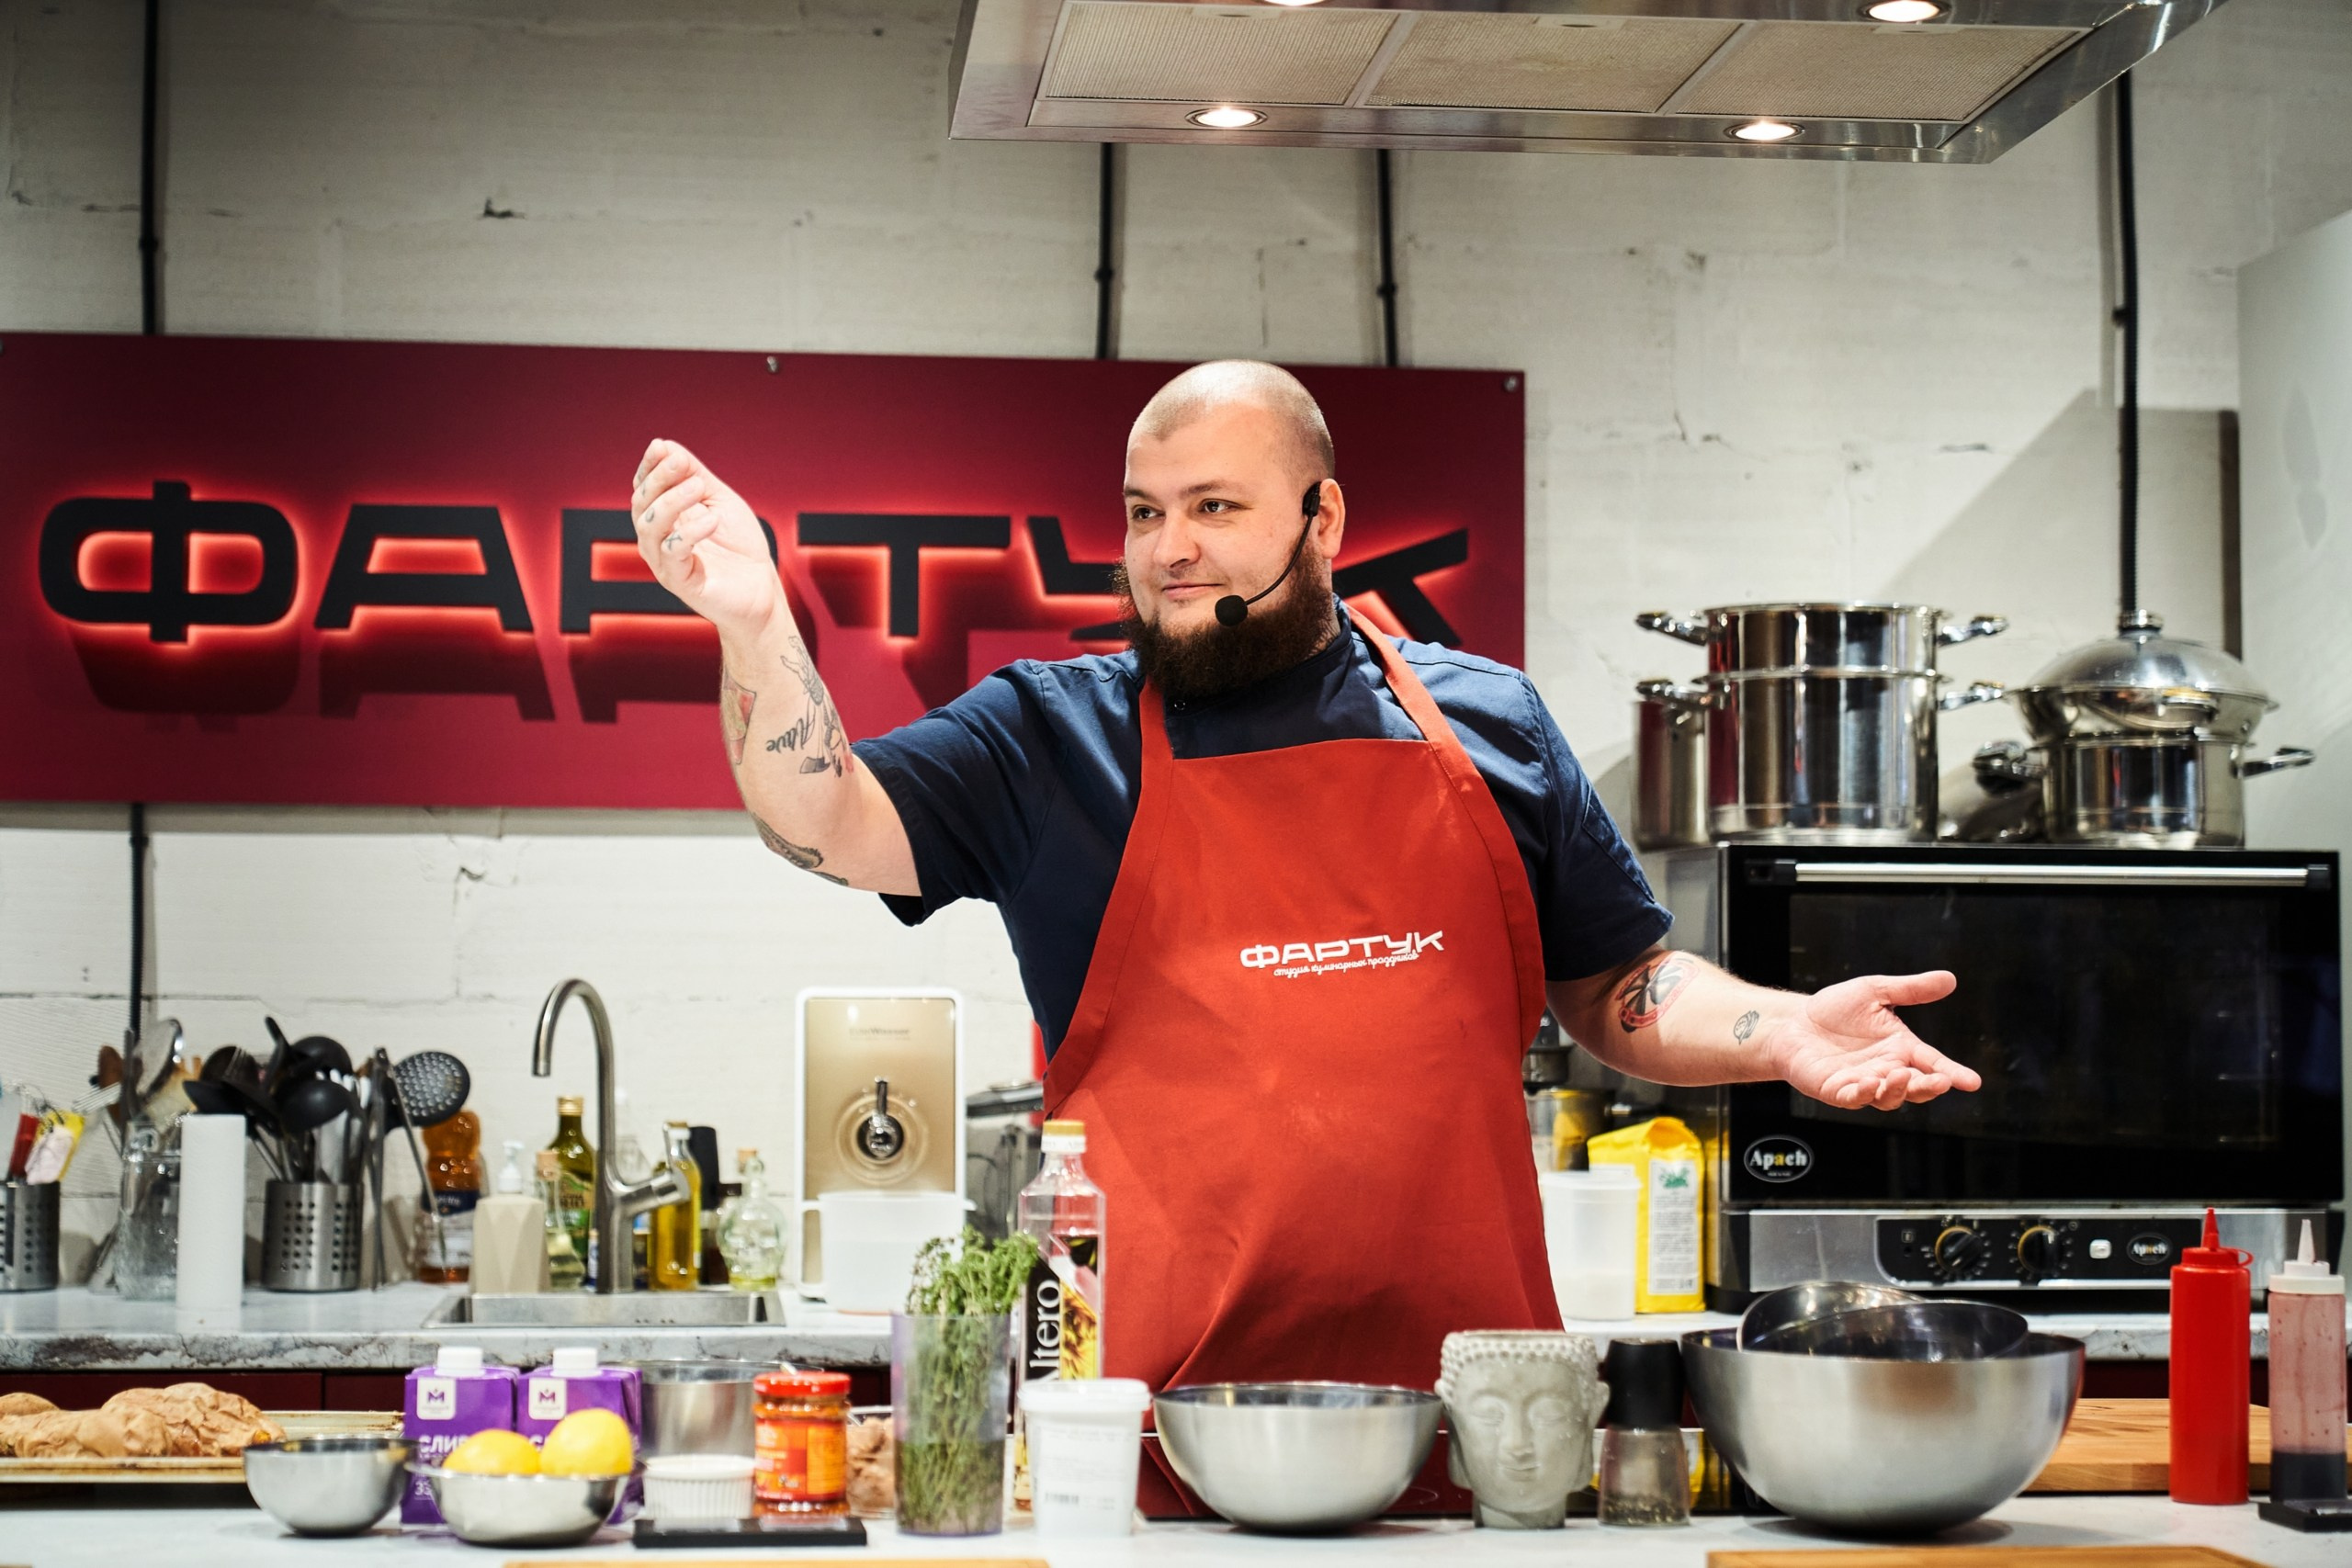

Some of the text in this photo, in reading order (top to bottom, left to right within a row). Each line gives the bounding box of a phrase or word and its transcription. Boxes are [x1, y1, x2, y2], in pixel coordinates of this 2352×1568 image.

[1239, 930, 1444, 969] ФАРТУК
[1273, 964, 1311, 979] студия
[1749, 1148, 1808, 1171] Apach
